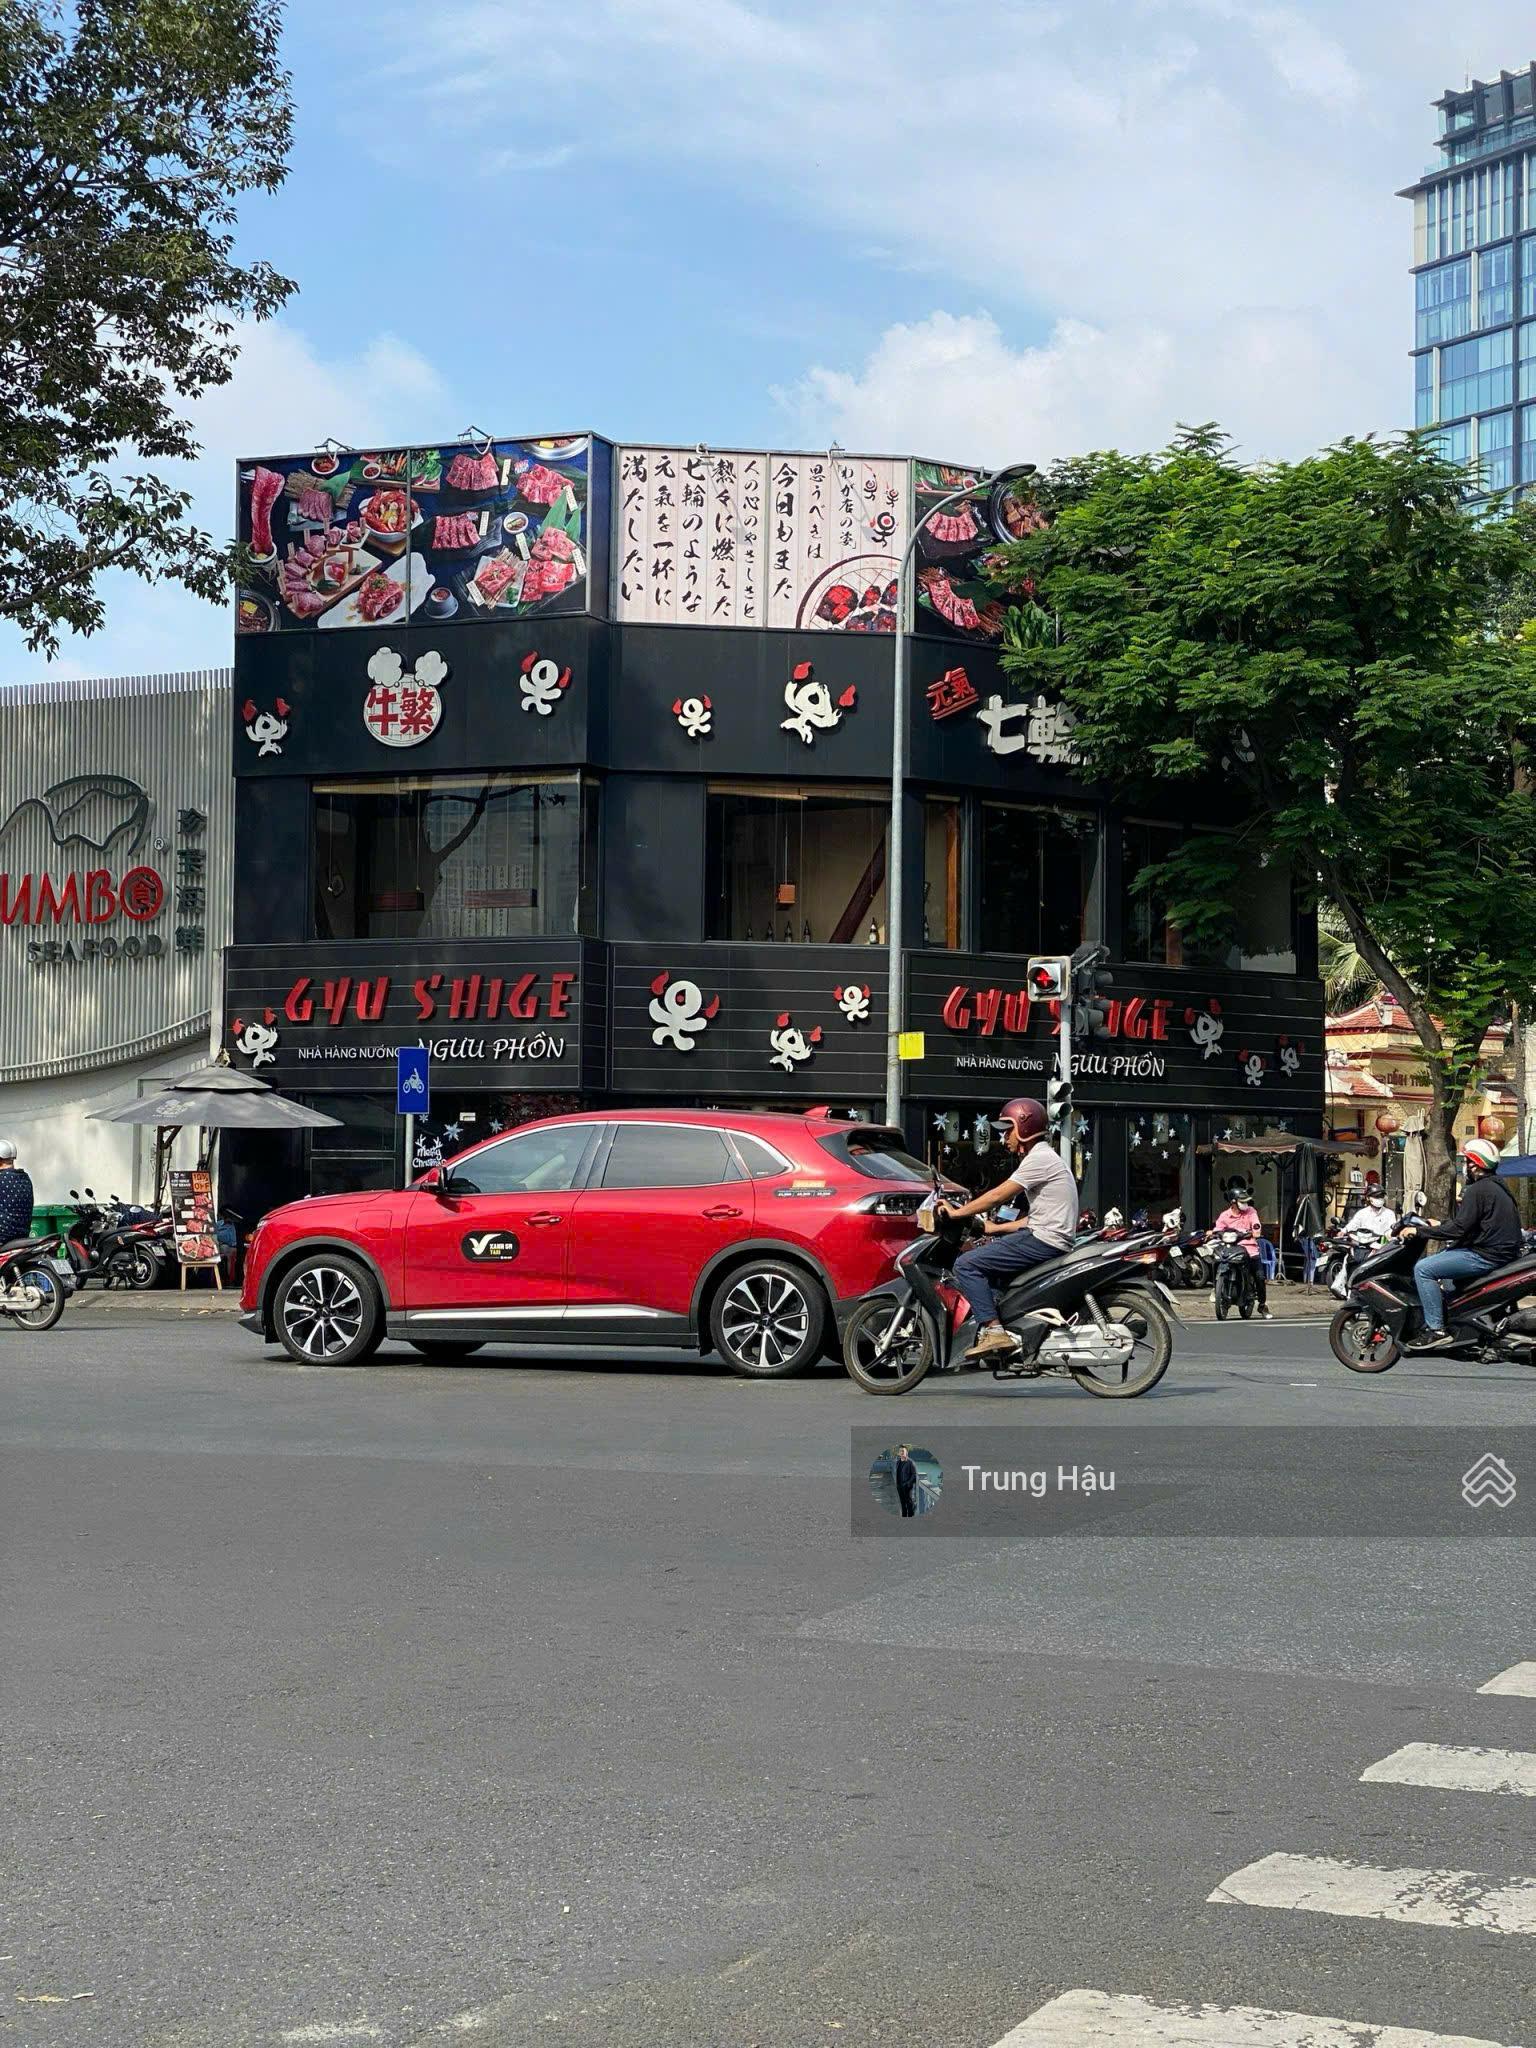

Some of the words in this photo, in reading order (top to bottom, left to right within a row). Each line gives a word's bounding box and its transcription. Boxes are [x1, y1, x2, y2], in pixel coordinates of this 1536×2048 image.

[621, 454, 648, 601] 満たしたい
[651, 455, 675, 606] 元氣を一杯に
[681, 457, 707, 613] 七輪のような
[711, 458, 737, 617] 熱々に燃えた
[743, 460, 760, 619] 人の心のやさしさと
[772, 462, 798, 600] 今日もまた
[807, 464, 826, 559] 思うべきは
[367, 687, 435, 736] 牛繁
[27, 934, 166, 963] SEAFOOD
[284, 976, 392, 1025] GYU
[943, 985, 1031, 1036] GYU
[298, 1045, 322, 1059] NHÀ
[324, 1044, 357, 1059] HÀNG
[493, 1030, 565, 1060] PHỒN
[956, 1056, 977, 1067] NHÀ
[978, 1054, 1006, 1069] HÀNG
